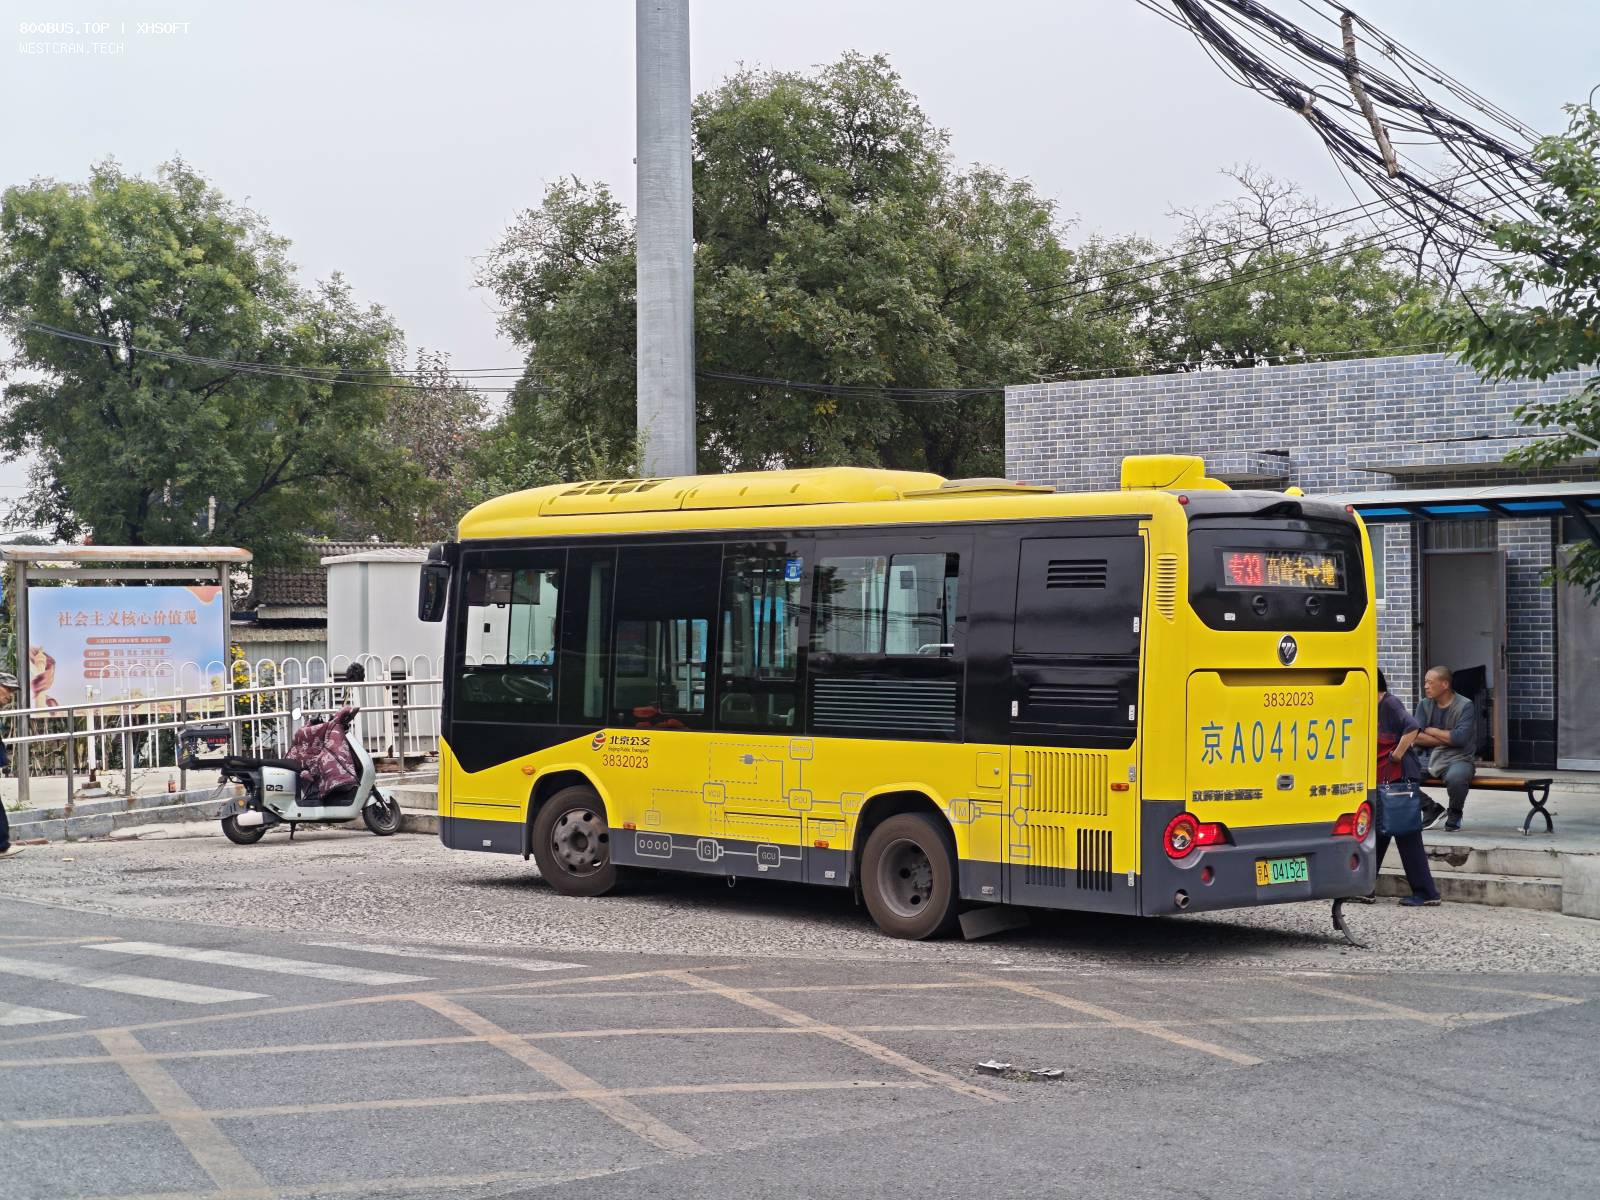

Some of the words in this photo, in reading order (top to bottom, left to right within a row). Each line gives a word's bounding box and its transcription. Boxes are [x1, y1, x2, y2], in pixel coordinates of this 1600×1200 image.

[58, 610, 198, 627] 社会主义核心价值观
[1263, 692, 1315, 707] 3832023
[609, 735, 651, 746] 北京公交
[1200, 718, 1353, 765] 京A04152F
[602, 754, 648, 769] 3832023
[958, 806, 966, 817] M
[704, 846, 711, 856] G
[762, 852, 776, 861] GCU
